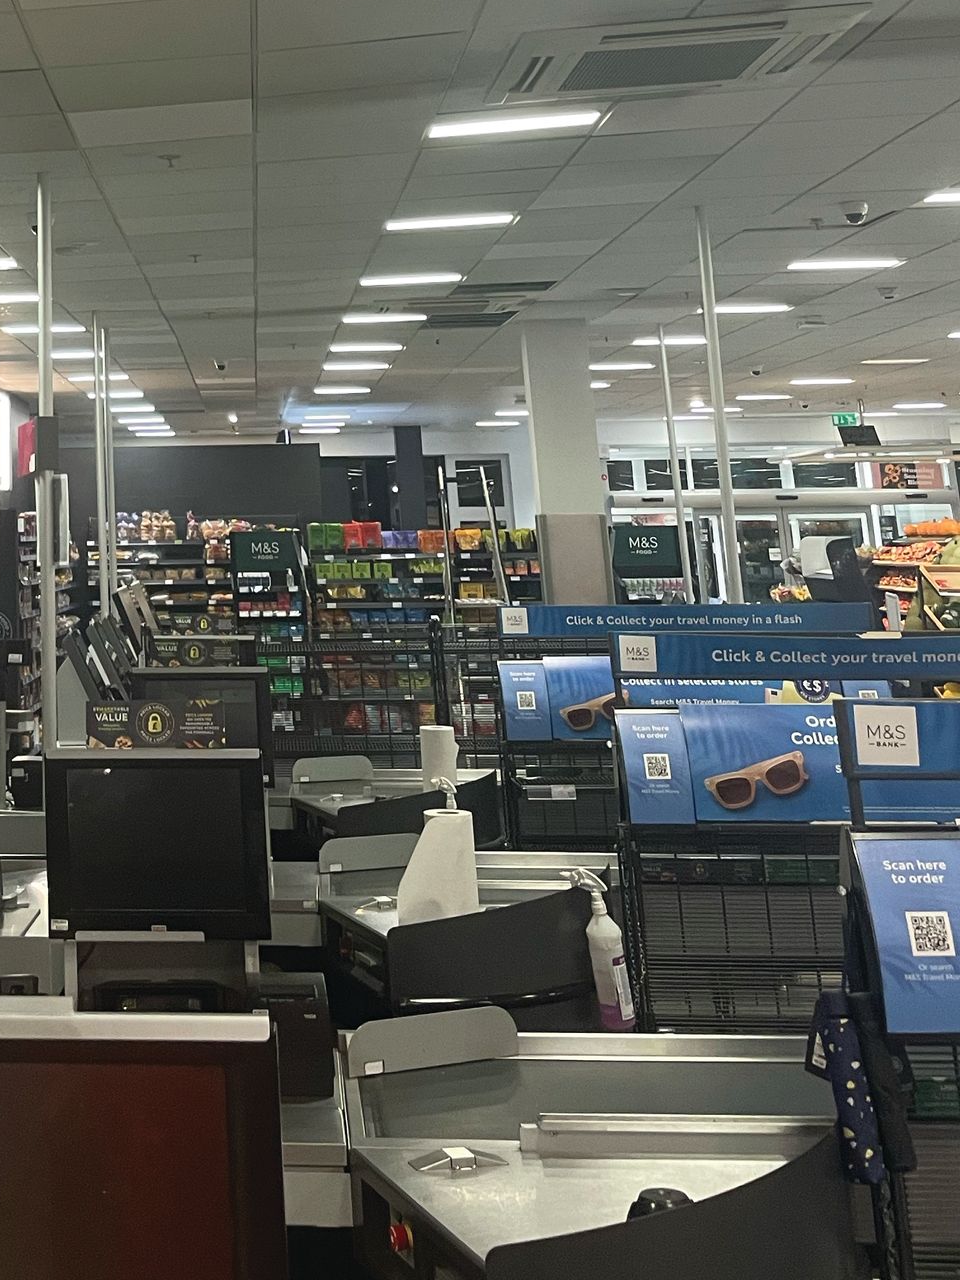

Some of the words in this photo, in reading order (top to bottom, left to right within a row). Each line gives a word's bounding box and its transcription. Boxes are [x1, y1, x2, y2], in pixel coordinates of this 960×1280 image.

[251, 541, 280, 554] M&S
[629, 536, 658, 548] M&S
[566, 615, 594, 625] Click
[596, 615, 604, 625] &
[606, 615, 647, 625] Collect
[649, 617, 675, 627] your
[677, 615, 710, 625] travel
[712, 616, 749, 626] money
[752, 614, 762, 624] in
[766, 616, 772, 624] a
[774, 614, 802, 624] flash
[626, 646, 650, 657] M&S
[711, 649, 751, 663] Click
[755, 650, 765, 663] &
[770, 651, 827, 663] Collect
[831, 653, 867, 666] your
[872, 651, 918, 663] travel
[95, 713, 129, 721] VALUE
[652, 724, 669, 732] here
[866, 724, 906, 739] M&S
[882, 860, 914, 871] Scan
[916, 859, 946, 870] here
[891, 873, 906, 884] to
[909, 872, 944, 883] order
